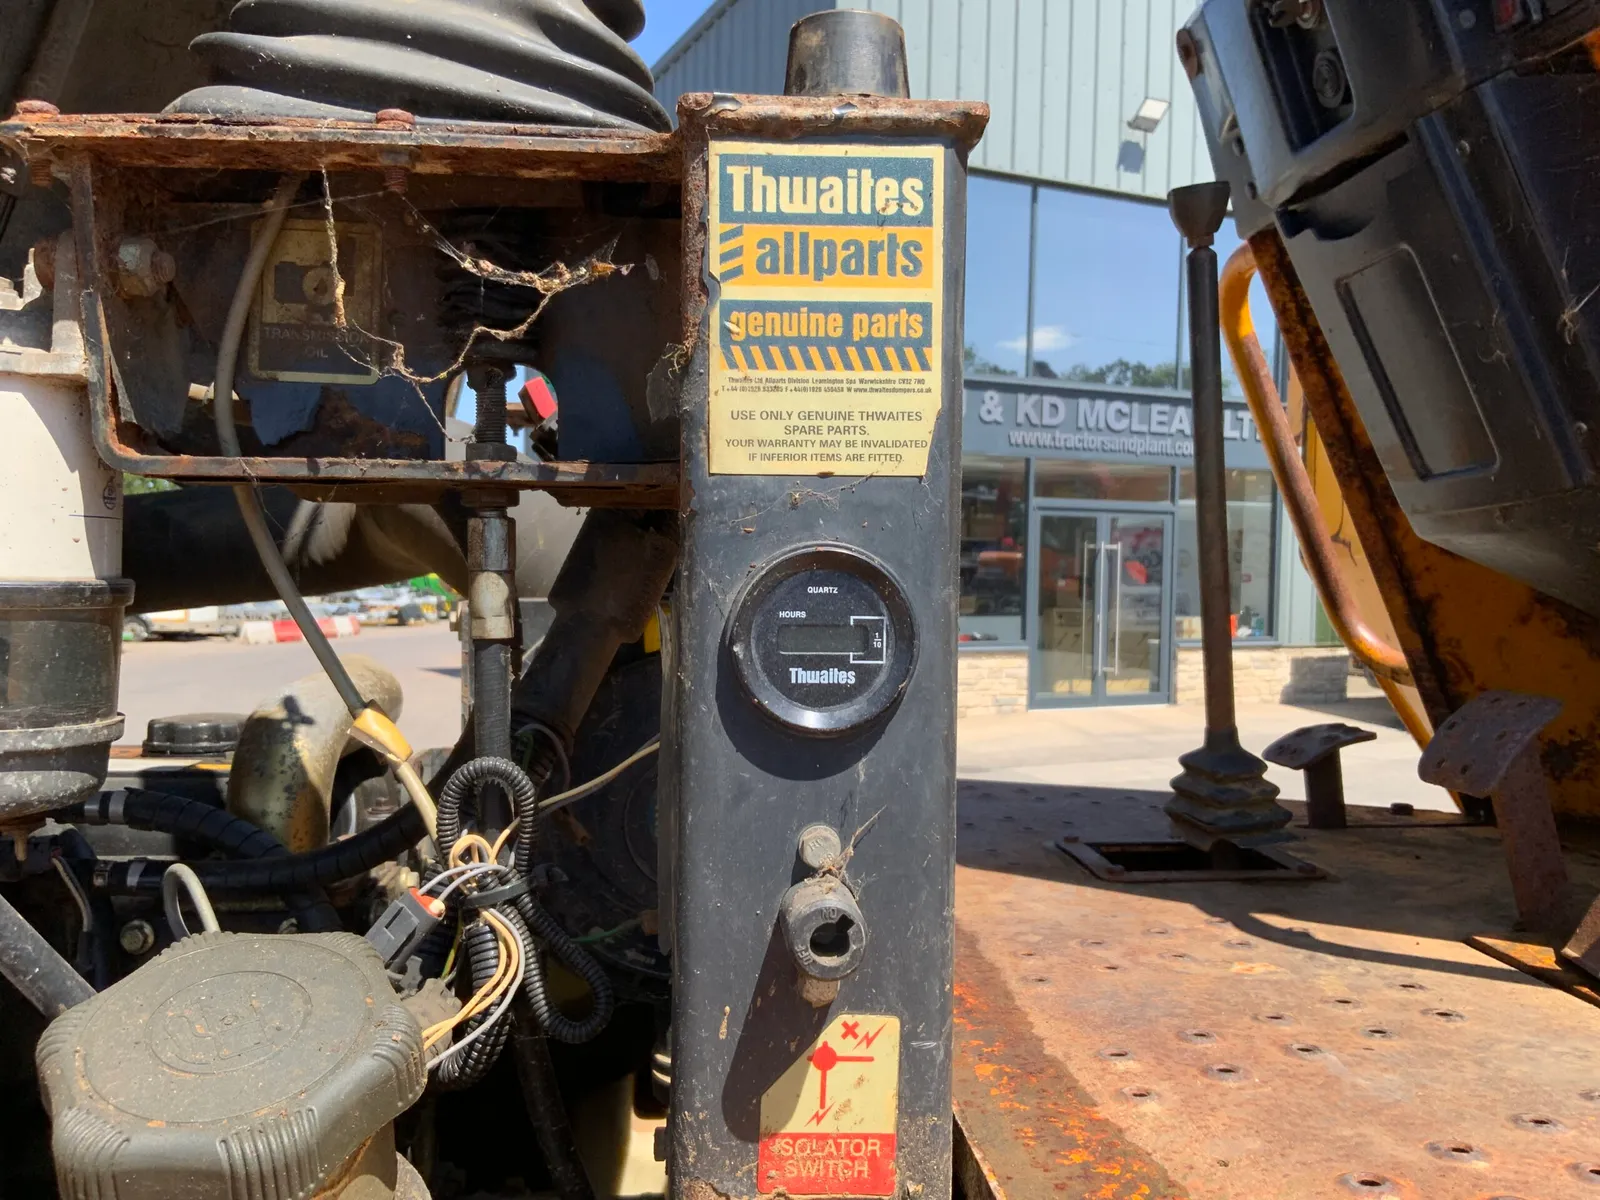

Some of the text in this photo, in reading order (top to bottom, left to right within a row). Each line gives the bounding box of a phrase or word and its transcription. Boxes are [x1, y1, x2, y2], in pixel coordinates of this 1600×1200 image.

[726, 165, 925, 216] Thwaites
[755, 231, 923, 282] allparts
[729, 306, 925, 342] genuine parts
[304, 345, 329, 358] OIL
[788, 377, 810, 385] Division
[811, 377, 844, 386] Leamington
[730, 410, 923, 422] USE ONLY GENUINE THWAITES
[979, 389, 1004, 424] &
[1016, 392, 1066, 427] KD
[1077, 397, 1193, 438] MCLEA
[1224, 408, 1261, 442] LT
[784, 425, 870, 436] SPARE PARTS.
[725, 439, 928, 449] YOUR WARRANTY MAY BE INVALIDATED
[1008, 430, 1194, 458] www.tractorsandplant.co
[748, 453, 905, 462] IF INFERIOR ITEMS ARE FITTED.
[807, 585, 839, 594] QUARTZ
[778, 610, 807, 618] HOURS
[788, 667, 856, 684] Thwaites
[785, 1160, 869, 1179] SWITCH
